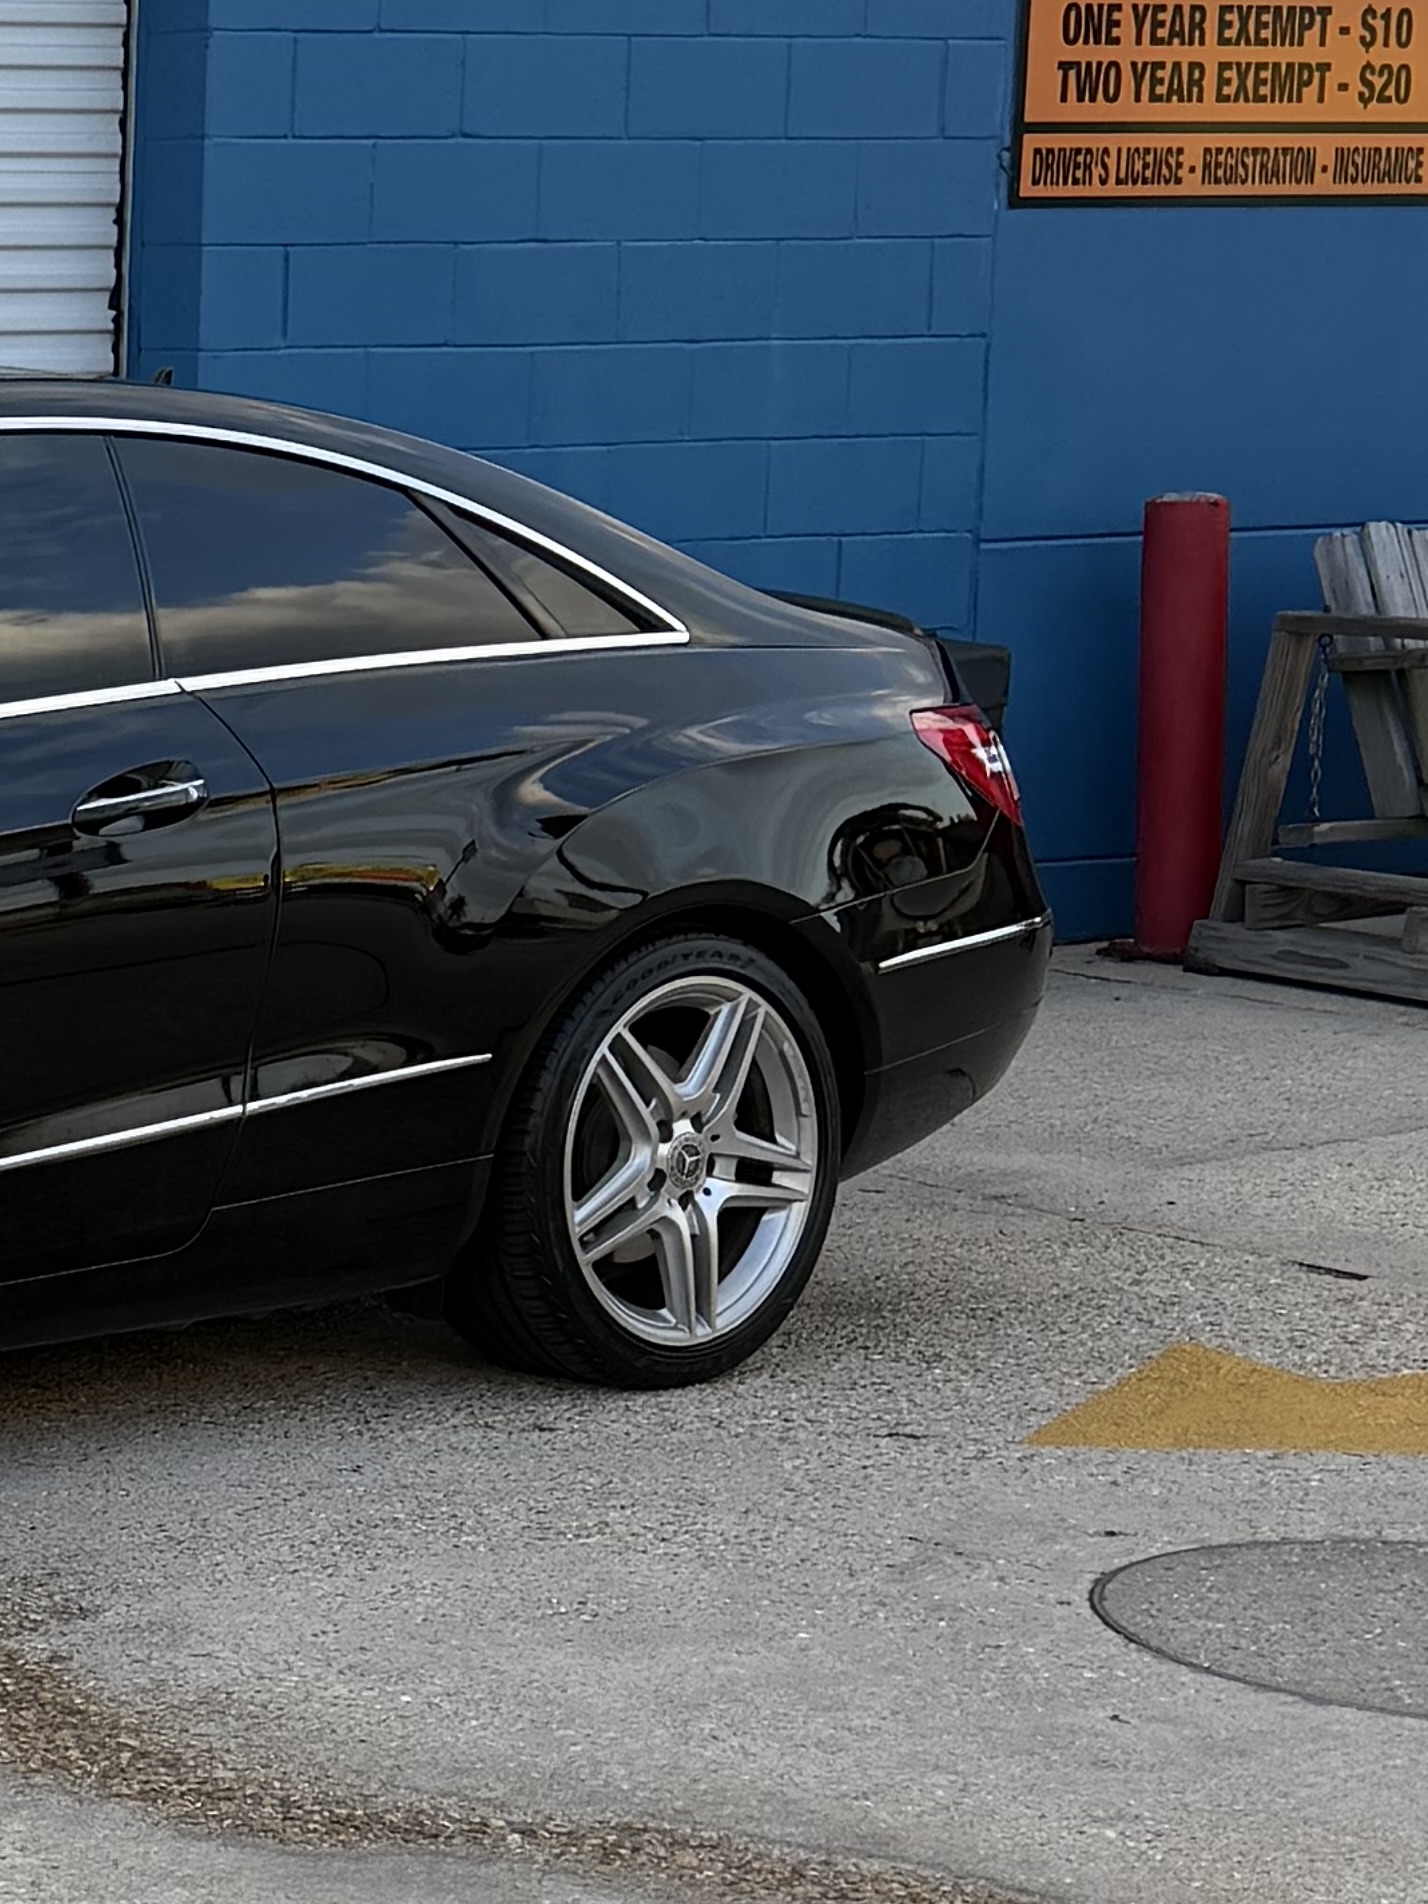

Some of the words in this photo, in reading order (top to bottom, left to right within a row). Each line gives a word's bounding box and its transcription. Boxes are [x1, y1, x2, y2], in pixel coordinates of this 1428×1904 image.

[1062, 3, 1123, 47] ONE
[1131, 3, 1206, 47] YEAR
[1217, 4, 1332, 47] EXEMPT
[1359, 4, 1413, 53] $10
[1058, 60, 1122, 103] TWO
[1130, 60, 1205, 103] YEAR
[1215, 61, 1331, 104] EXEMPT
[1358, 60, 1411, 109] $20
[1031, 147, 1110, 187] DRIVER'S
[1115, 147, 1184, 186] LICENSE
[1201, 147, 1316, 186] REGISTRATION
[1333, 146, 1424, 185] INSURANCE
